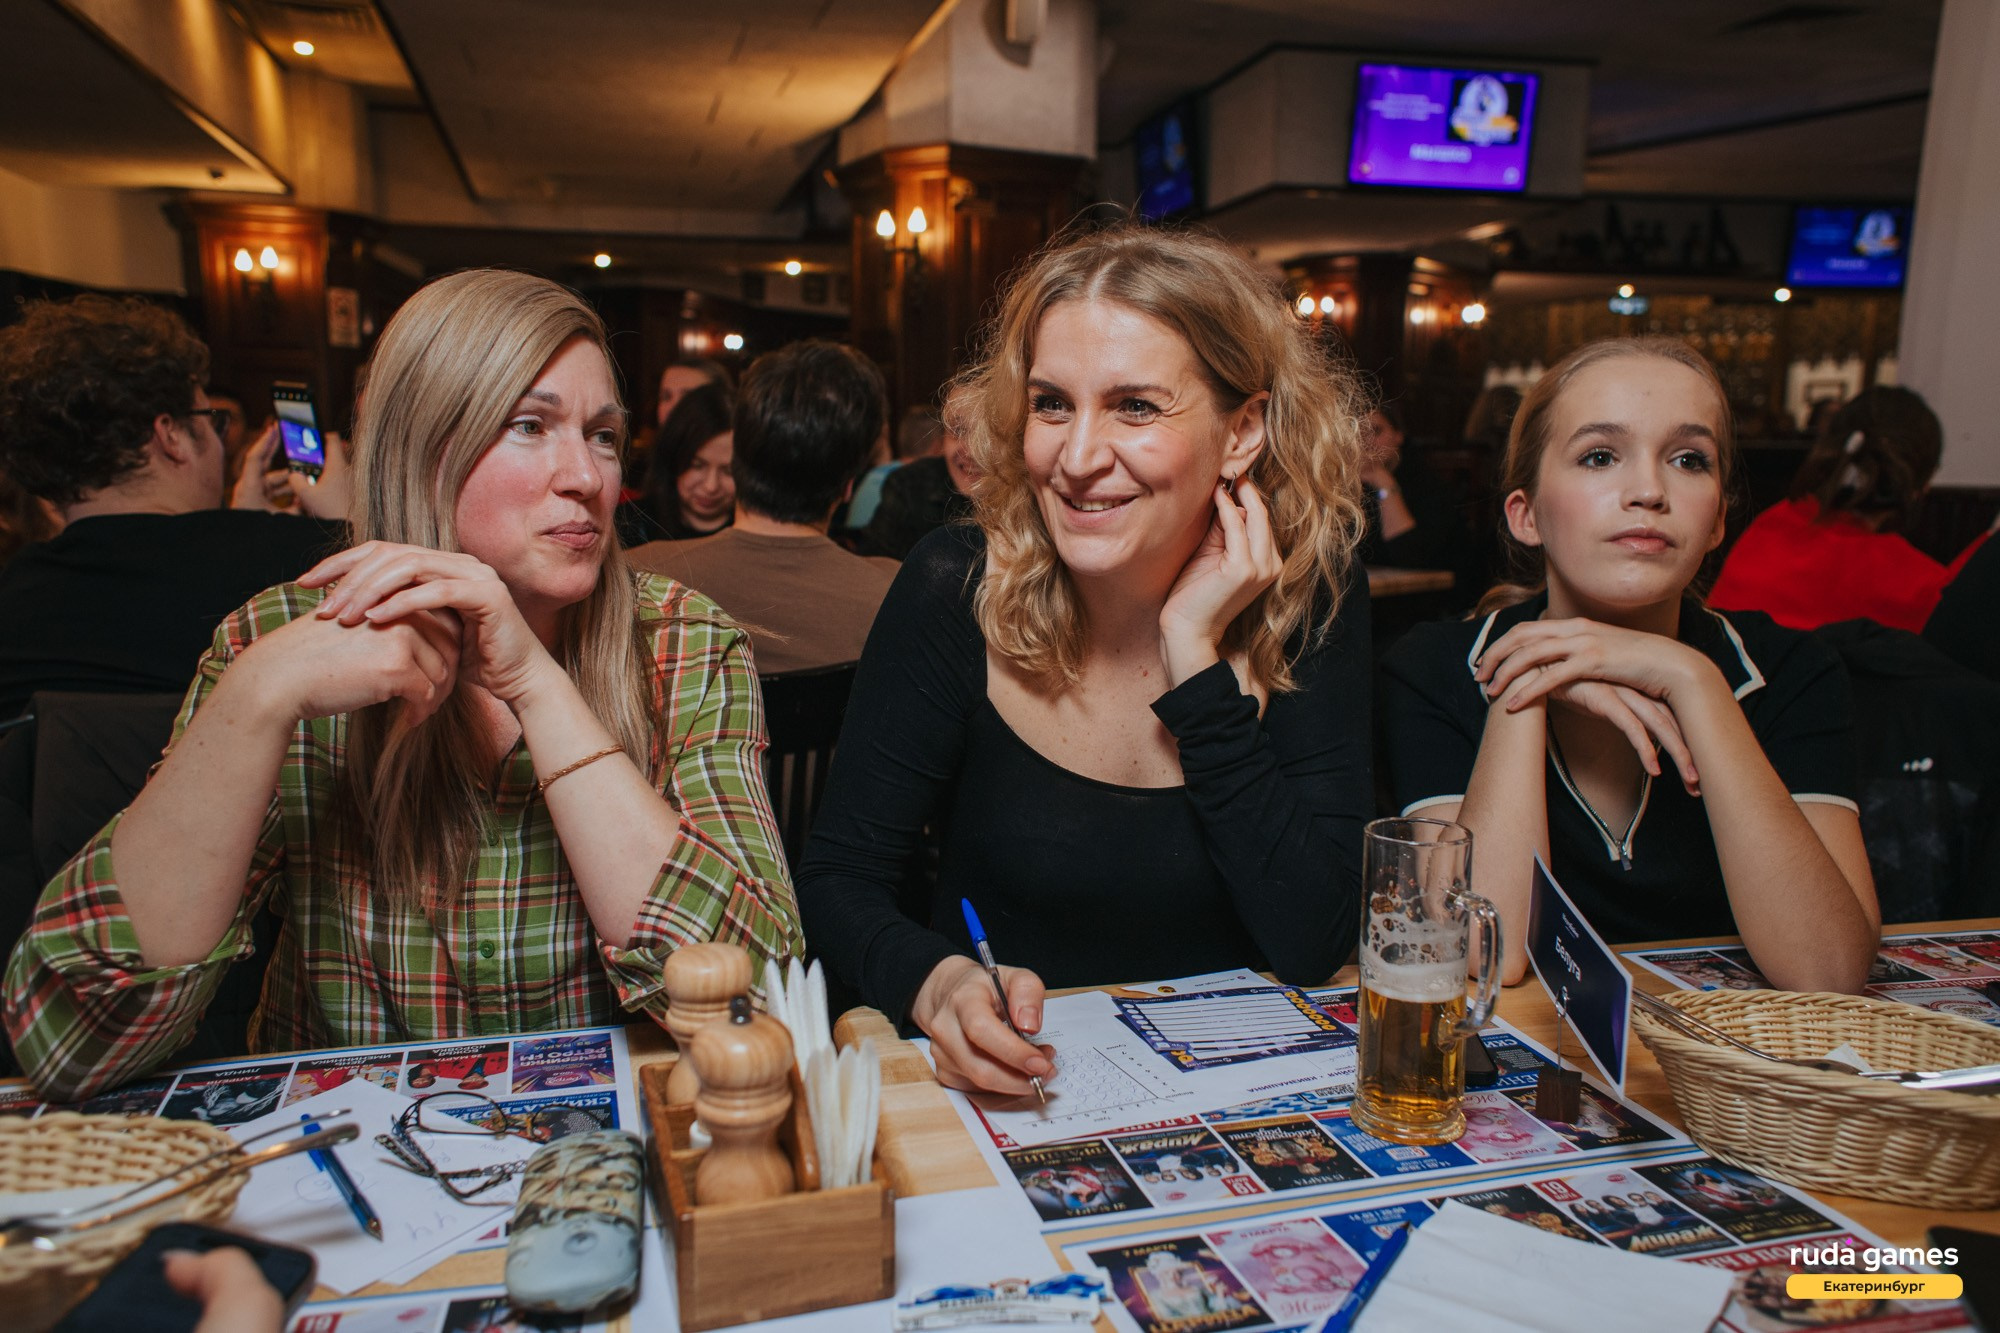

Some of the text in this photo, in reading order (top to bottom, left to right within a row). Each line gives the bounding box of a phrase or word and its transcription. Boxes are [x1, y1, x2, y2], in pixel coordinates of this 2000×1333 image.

[1555, 935, 1582, 981] Белуга
[431, 1044, 487, 1054] КОРОВКА
[437, 1048, 479, 1056] БОЖЬЯ
[534, 1042, 572, 1050] МАРТА
[310, 1054, 392, 1066] ИМЕНИННИКА
[433, 1054, 471, 1062] МАРТА
[519, 1046, 607, 1062] РЕТРО FM
[519, 1053, 608, 1067] ВЕЧЕРИНКА
[335, 1059, 367, 1067] ДЕНЬ
[214, 1067, 261, 1077] ЛИНДА
[206, 1076, 254, 1086] АПРЕЛЯ
[1247, 1075, 1318, 1093] КВИЗМАШИНА
[1228, 1127, 1283, 1141] радости
[1256, 1128, 1321, 1142] Баварские
[1117, 1131, 1207, 1155] Мираж
[1502, 1148, 1540, 1157] МАРТА
[1233, 1181, 1259, 1194] 19
[1293, 1176, 1330, 1187] МАРТА
[1540, 1180, 1568, 1194] 19
[1469, 1191, 1509, 1202] МАРТА
[1627, 1224, 1716, 1252] Мираж
[1130, 1242, 1178, 1257] МАРТА
